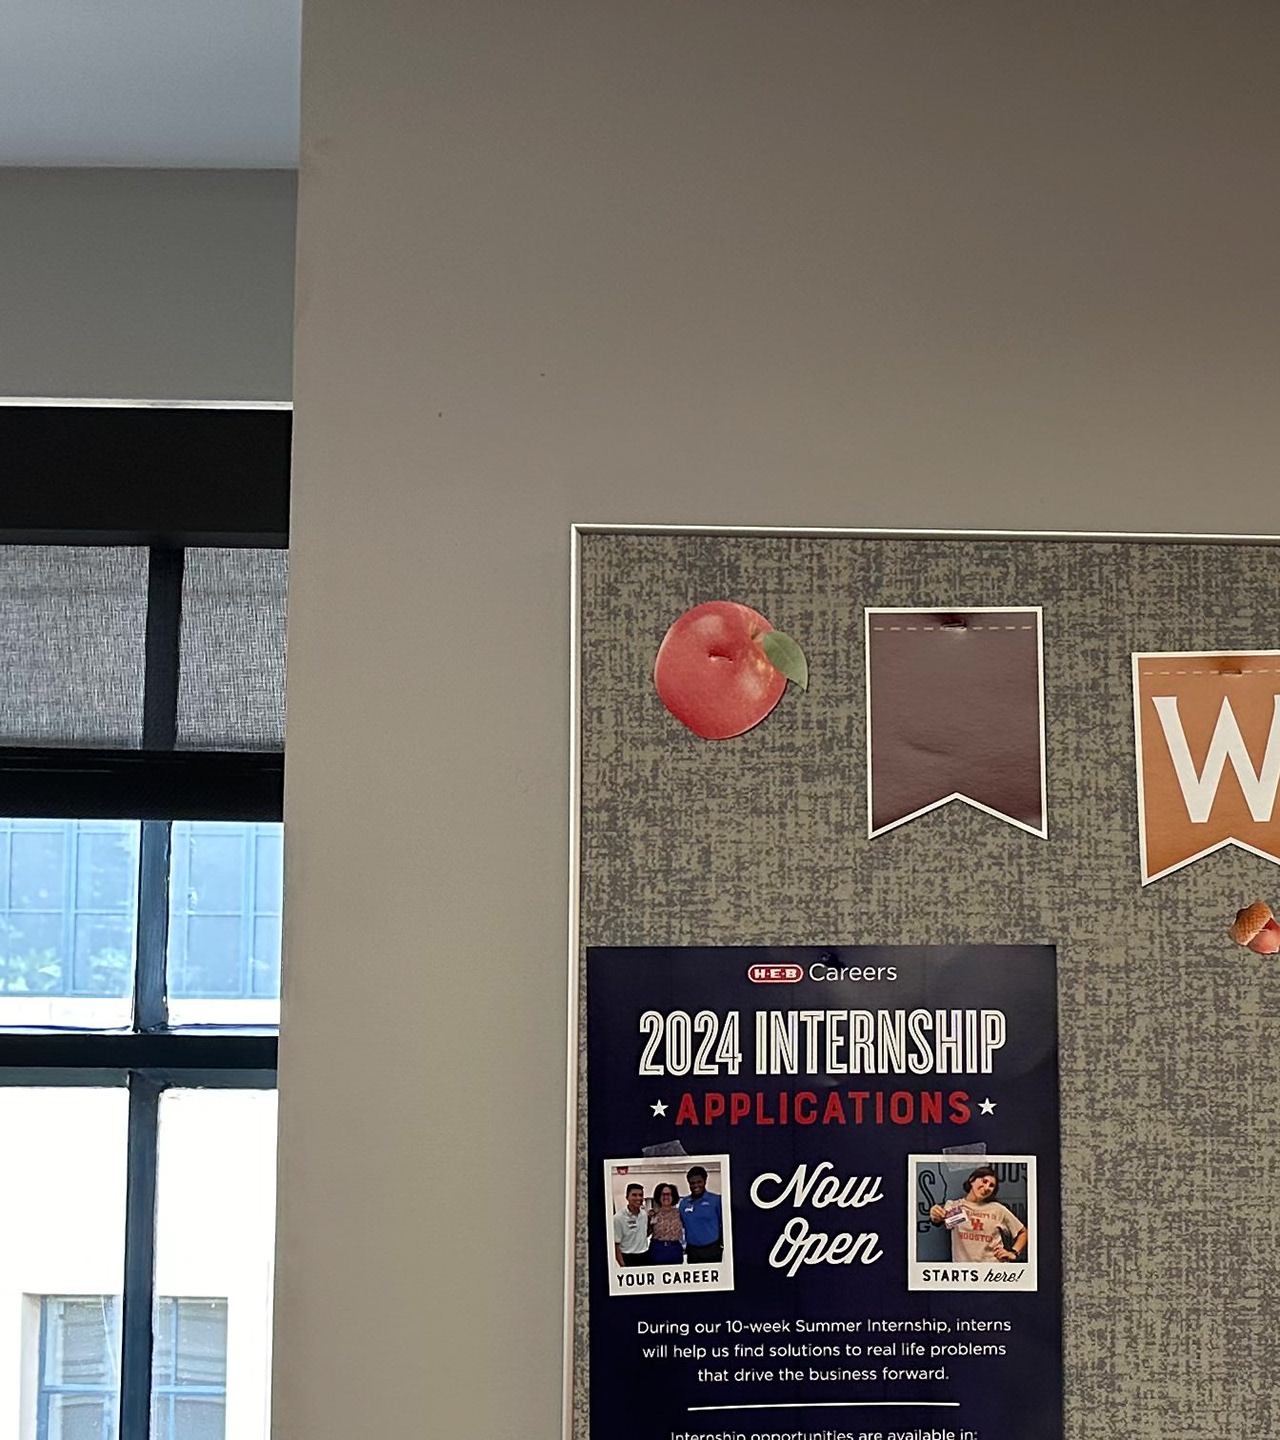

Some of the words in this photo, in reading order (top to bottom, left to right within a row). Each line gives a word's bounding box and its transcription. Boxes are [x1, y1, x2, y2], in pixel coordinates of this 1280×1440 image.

[809, 963, 898, 982] Careers
[638, 1010, 743, 1076] 2024
[755, 1008, 1006, 1075] INTERNSHIP
[676, 1091, 971, 1125] APPLICATIONS
[750, 1161, 884, 1209] Now
[768, 1216, 884, 1278] Open
[616, 1272, 655, 1287] YOUR
[662, 1270, 719, 1285] CAREER
[922, 1269, 979, 1282] STARTS
[983, 1268, 1025, 1283] here!
[637, 1321, 690, 1336] During
[694, 1323, 722, 1334] our
[725, 1319, 791, 1333] 10-week
[795, 1319, 862, 1333] Summer
[867, 1318, 951, 1334] Internship,
[956, 1318, 1012, 1332] interns
[960, 1428, 978, 1440] in:
